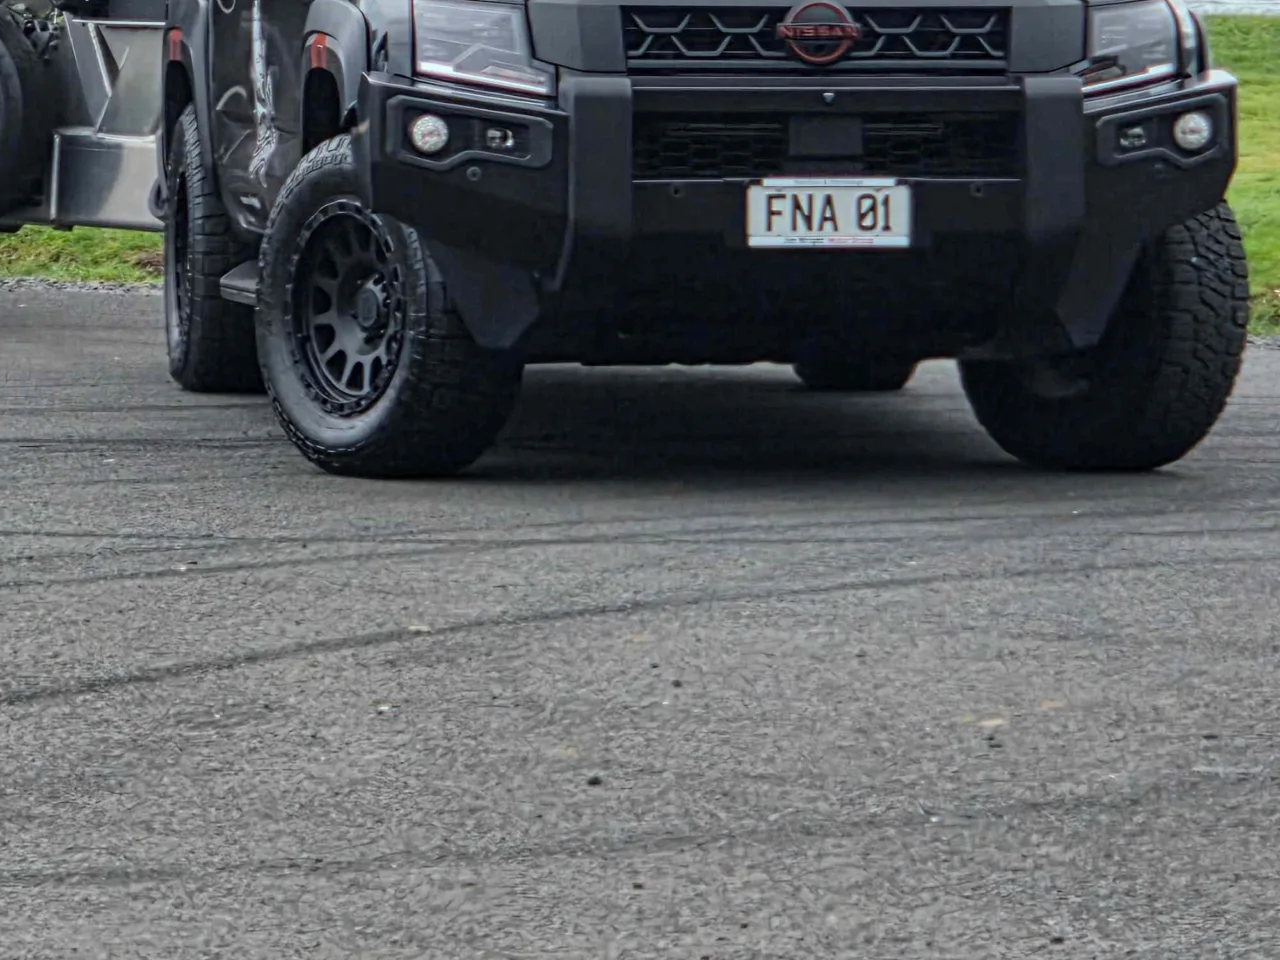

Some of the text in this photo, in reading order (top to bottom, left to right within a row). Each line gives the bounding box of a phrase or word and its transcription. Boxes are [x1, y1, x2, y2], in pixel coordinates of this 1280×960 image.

[779, 25, 858, 38] NISSAN
[765, 193, 892, 232] FNA 01
